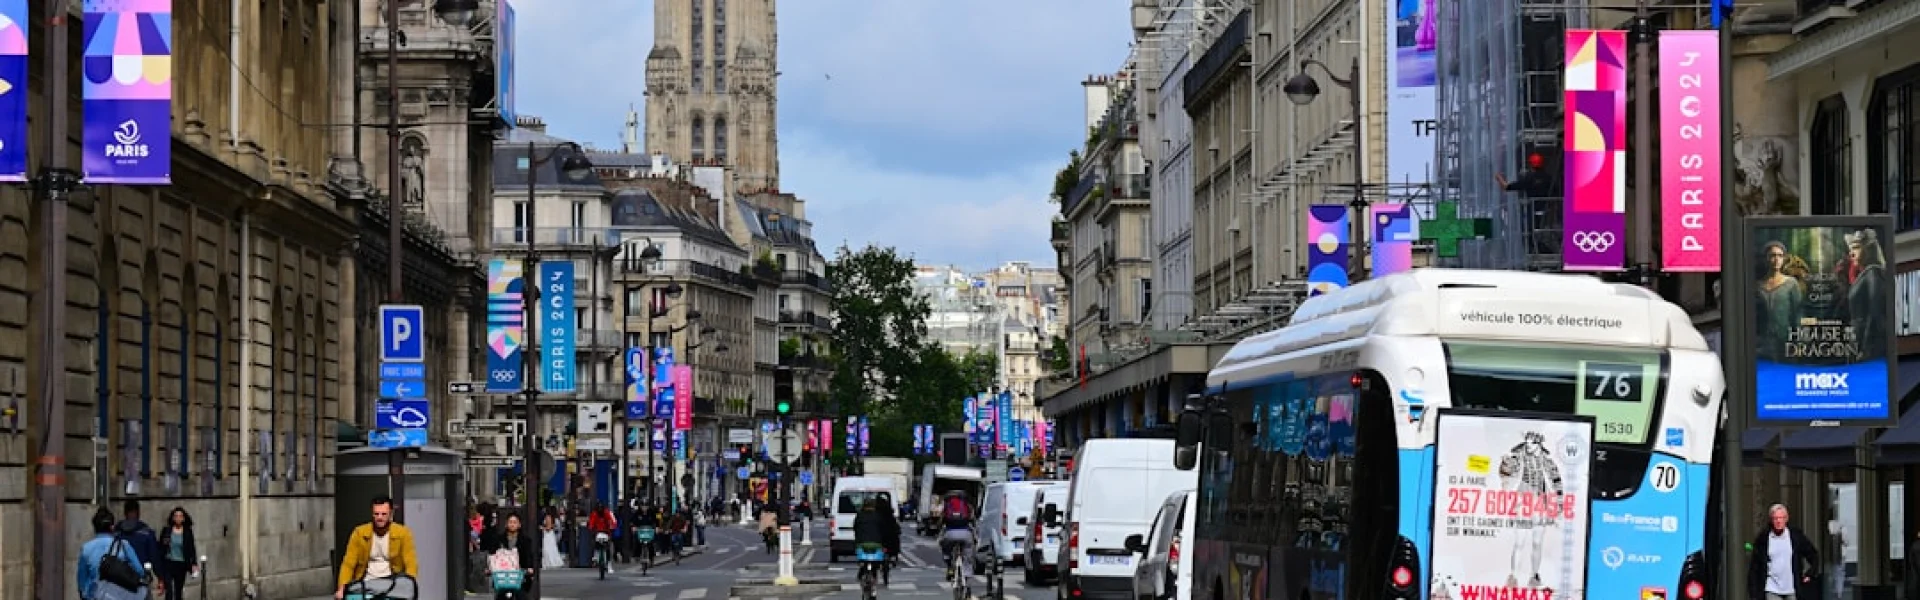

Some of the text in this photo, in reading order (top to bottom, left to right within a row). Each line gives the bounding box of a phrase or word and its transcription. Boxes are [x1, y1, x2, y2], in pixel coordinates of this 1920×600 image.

[105, 144, 149, 157] PARIS
[1679, 51, 1703, 251] PARIS 2024
[551, 271, 565, 381] PARIS 2024
[1460, 311, 1622, 329] véhicule 100% électrique
[392, 317, 411, 350] P
[1788, 326, 1841, 341] HOUSE
[1785, 342, 1859, 357] DRAGON
[1594, 370, 1631, 397] 76
[1795, 373, 1849, 390] max
[1603, 423, 1633, 434] 1530
[1566, 445, 1577, 456] W
[1656, 467, 1675, 488] 70
[1448, 487, 1577, 520] 257 602 945 €
[1627, 554, 1662, 563] RATP
